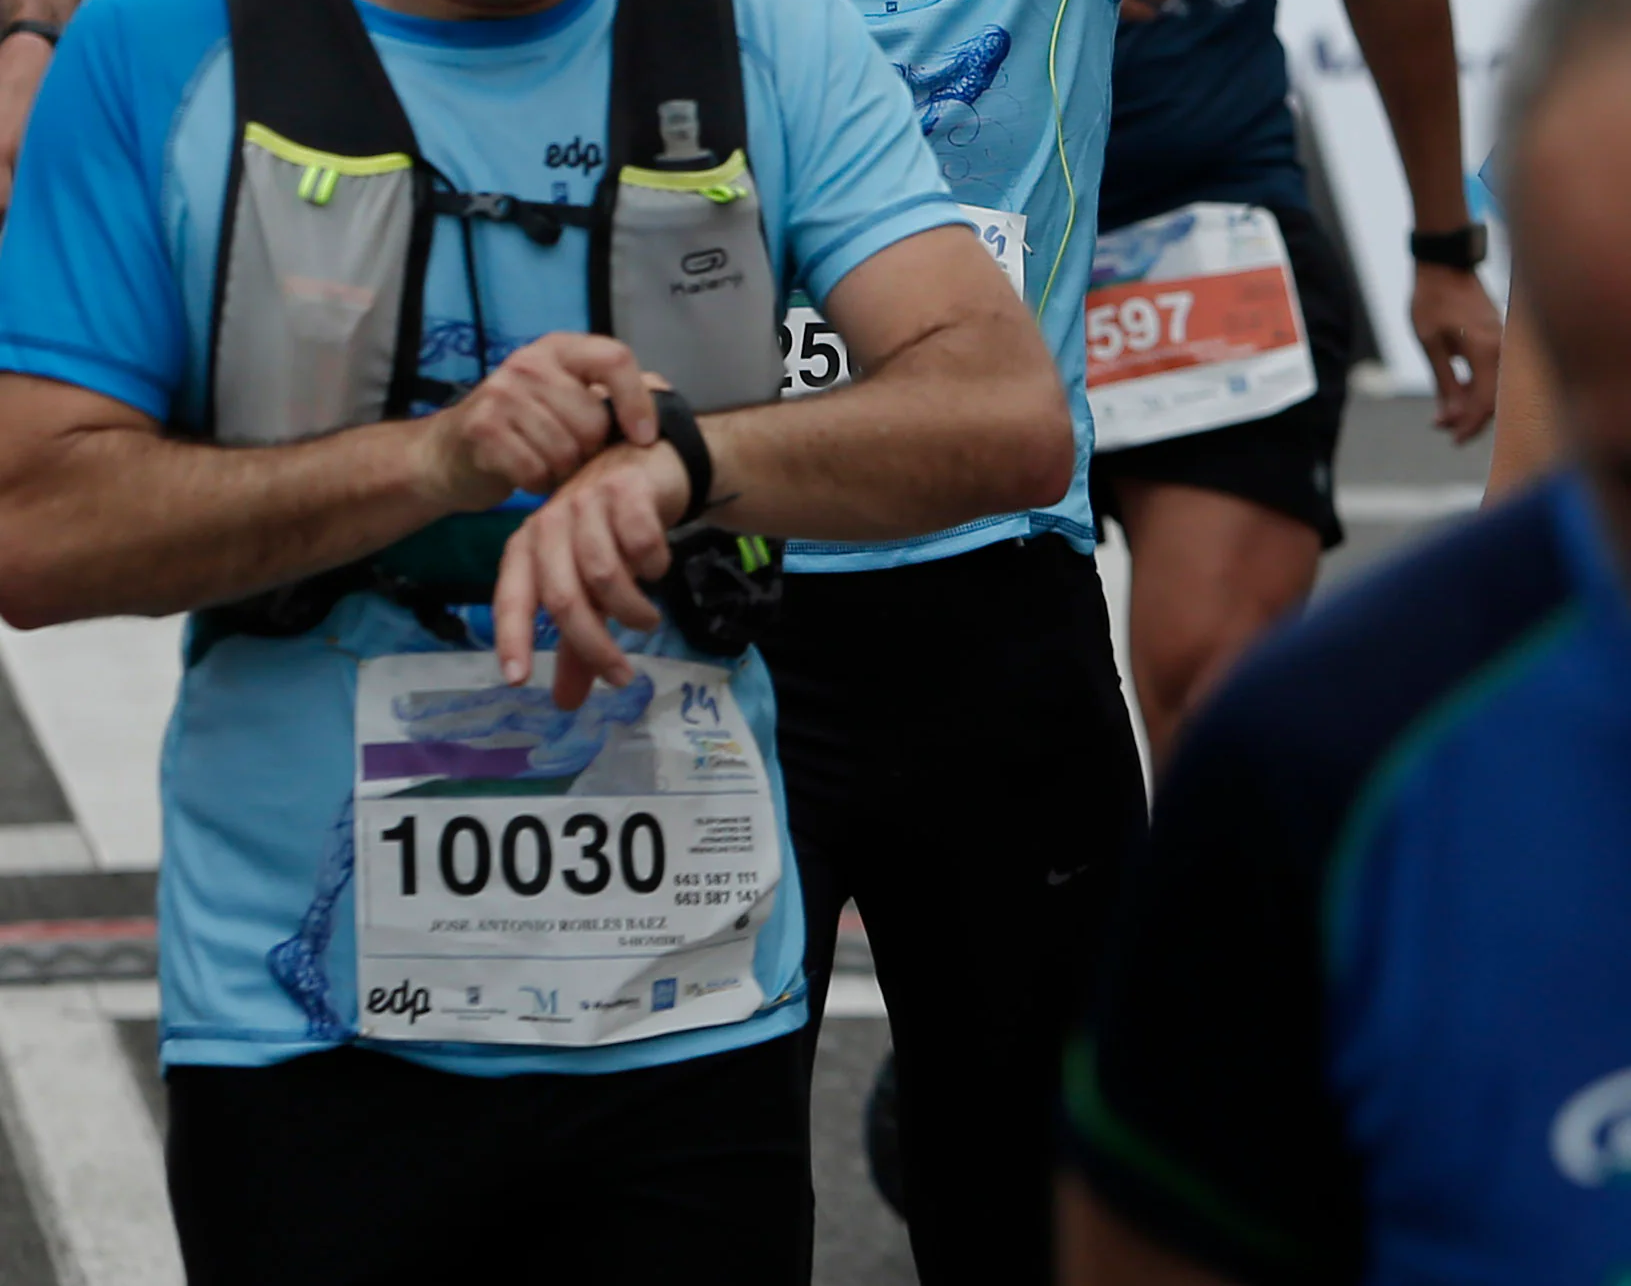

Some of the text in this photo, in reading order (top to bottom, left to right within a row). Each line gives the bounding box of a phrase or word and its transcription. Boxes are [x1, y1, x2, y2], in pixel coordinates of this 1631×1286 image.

[544, 135, 602, 176] edp
[378, 812, 666, 897] 10030
[476, 918, 555, 933] ANTONIO
[558, 918, 622, 932] ROBLES
[625, 917, 668, 931] BAEZ
[366, 978, 432, 1025] edp
